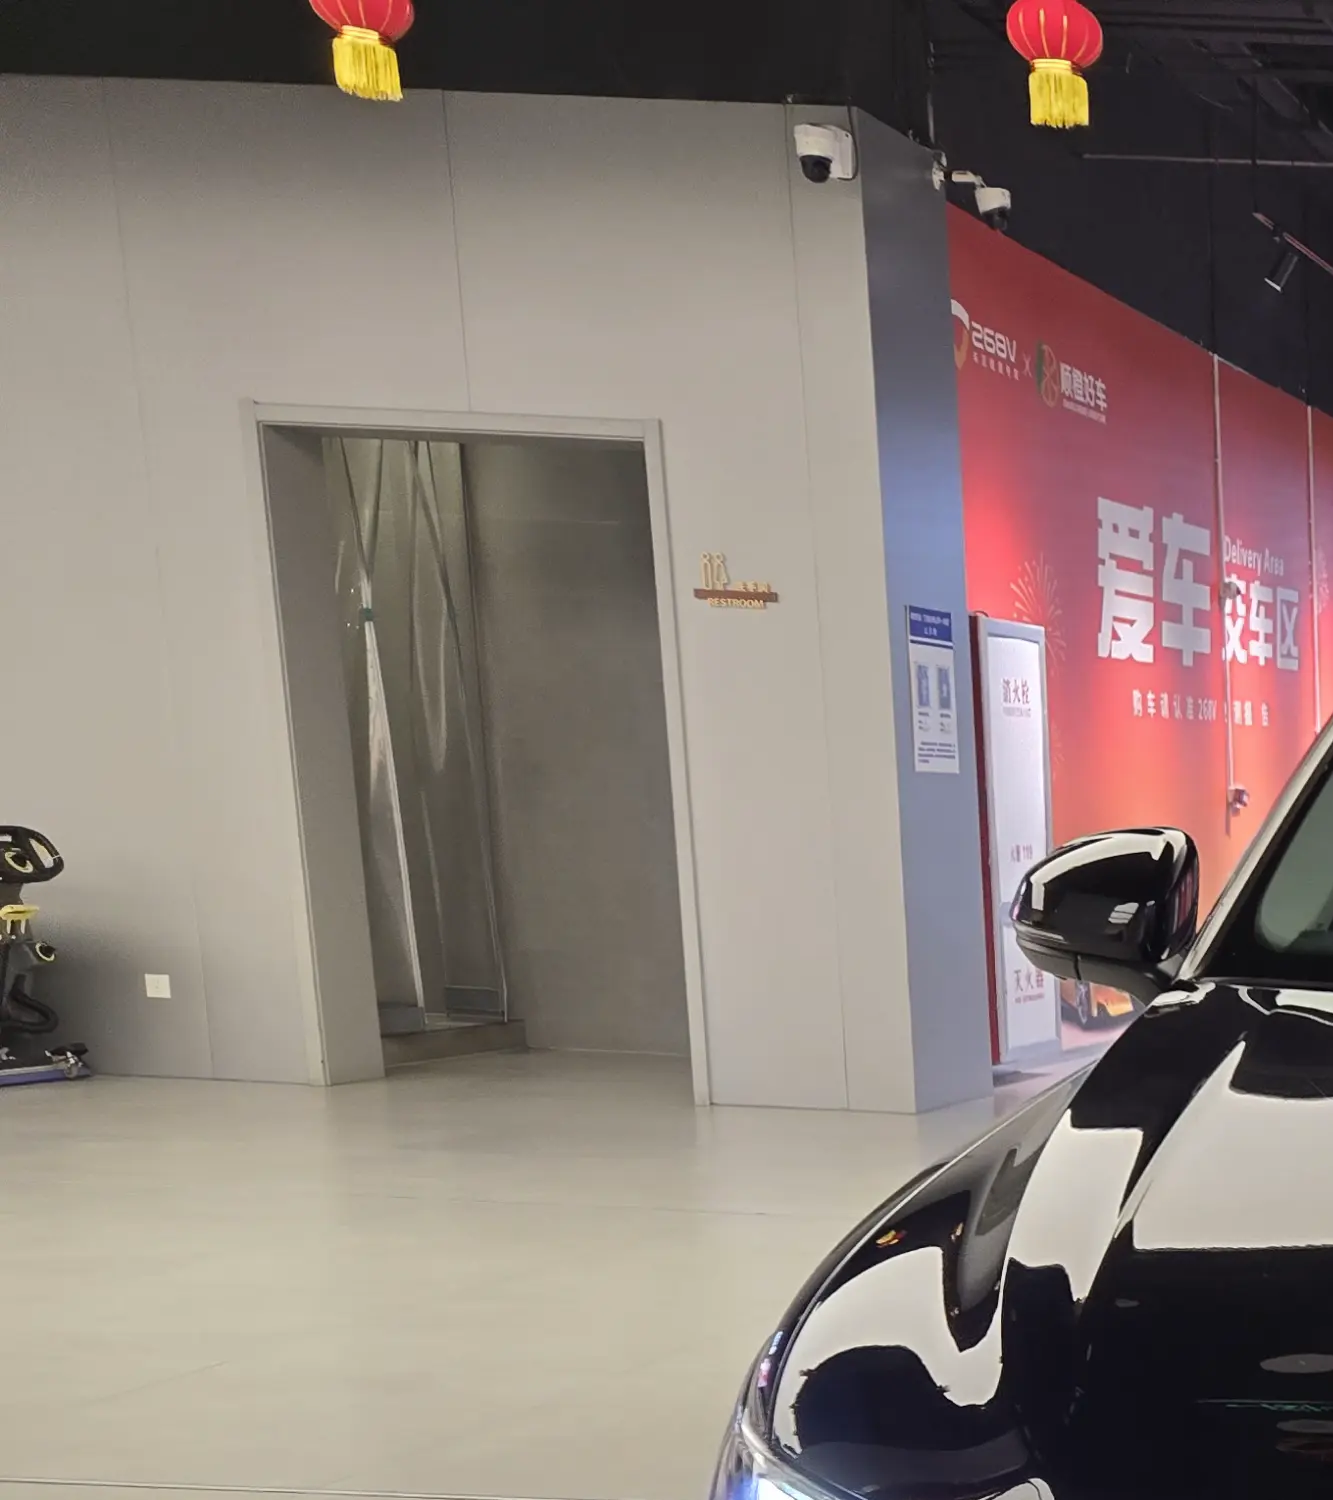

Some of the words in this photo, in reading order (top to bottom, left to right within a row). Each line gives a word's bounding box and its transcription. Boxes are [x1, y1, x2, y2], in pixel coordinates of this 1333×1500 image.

[972, 321, 1016, 363] 268V
[1224, 536, 1262, 576] Delivery
[1264, 548, 1285, 576] Area
[708, 598, 765, 609] RESTROOM
[1098, 497, 1211, 667] 爱车
[1223, 574, 1298, 670] 交车区
